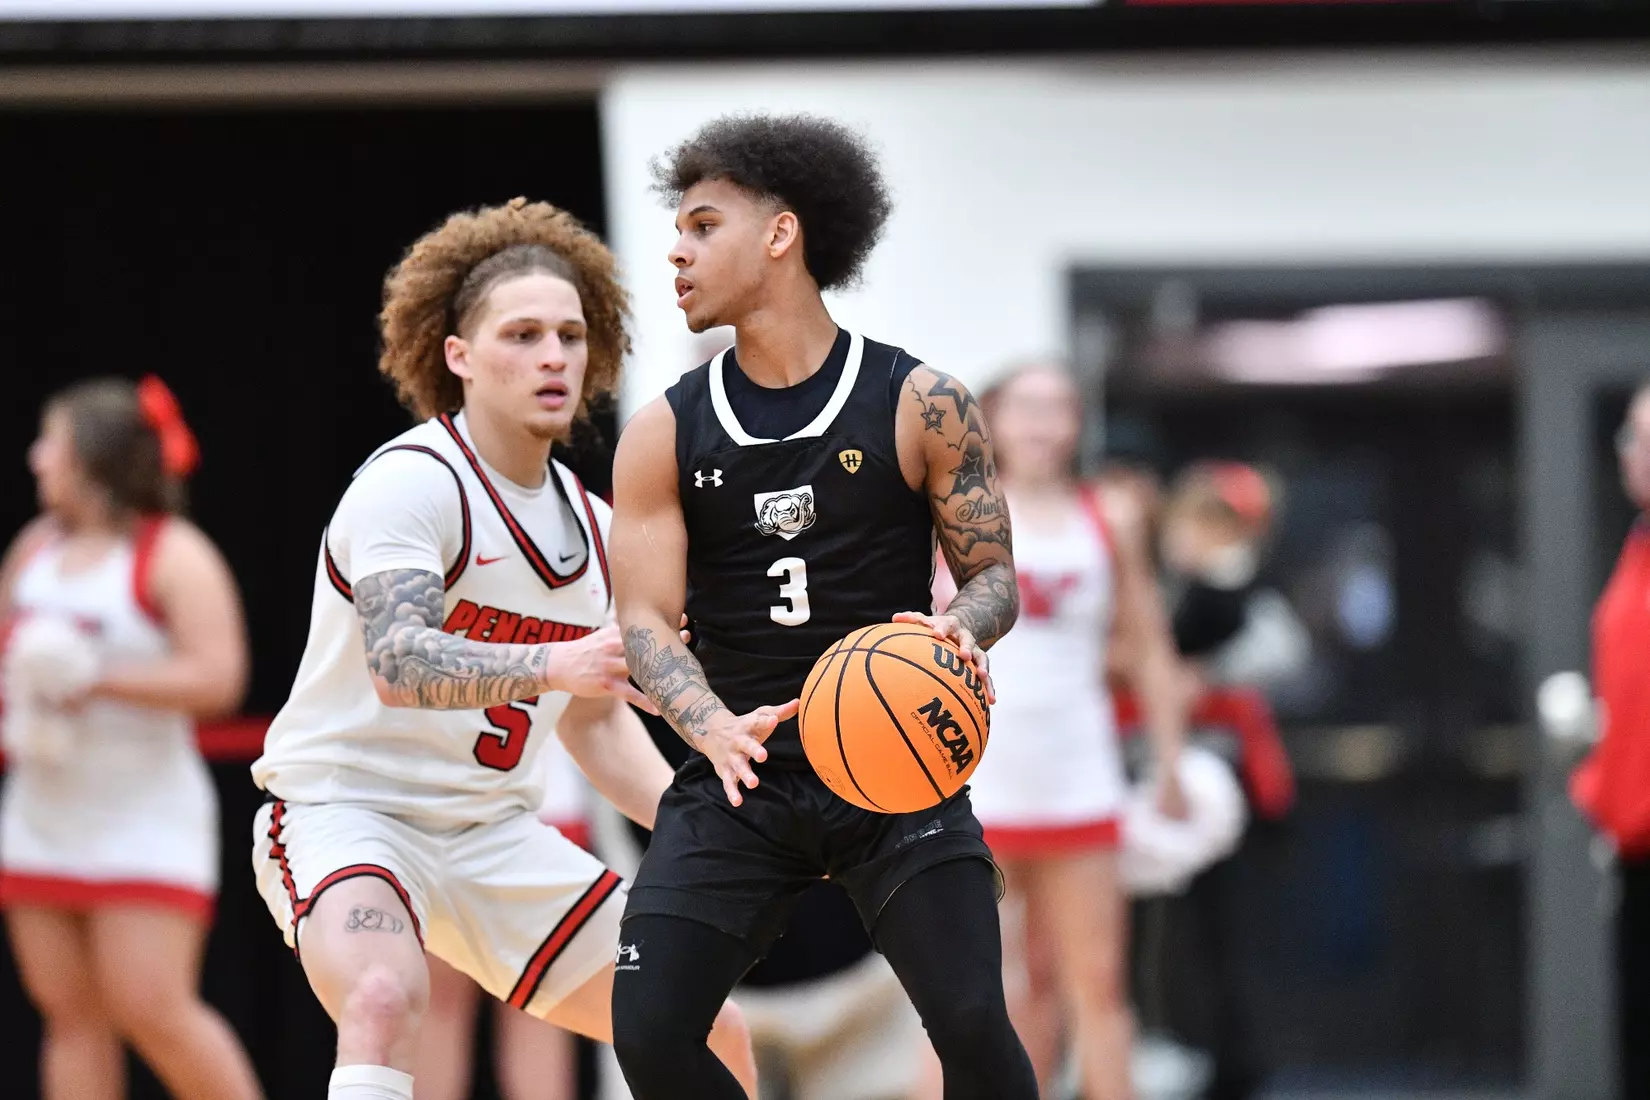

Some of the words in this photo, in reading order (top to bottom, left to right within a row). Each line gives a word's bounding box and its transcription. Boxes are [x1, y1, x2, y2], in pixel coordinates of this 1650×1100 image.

[442, 598, 600, 645] PENGUI
[766, 557, 811, 626] 3
[472, 695, 540, 772] 5
[910, 711, 935, 744] OFFICIAL
[934, 743, 949, 763] GAME
[917, 696, 974, 775] NCAA
